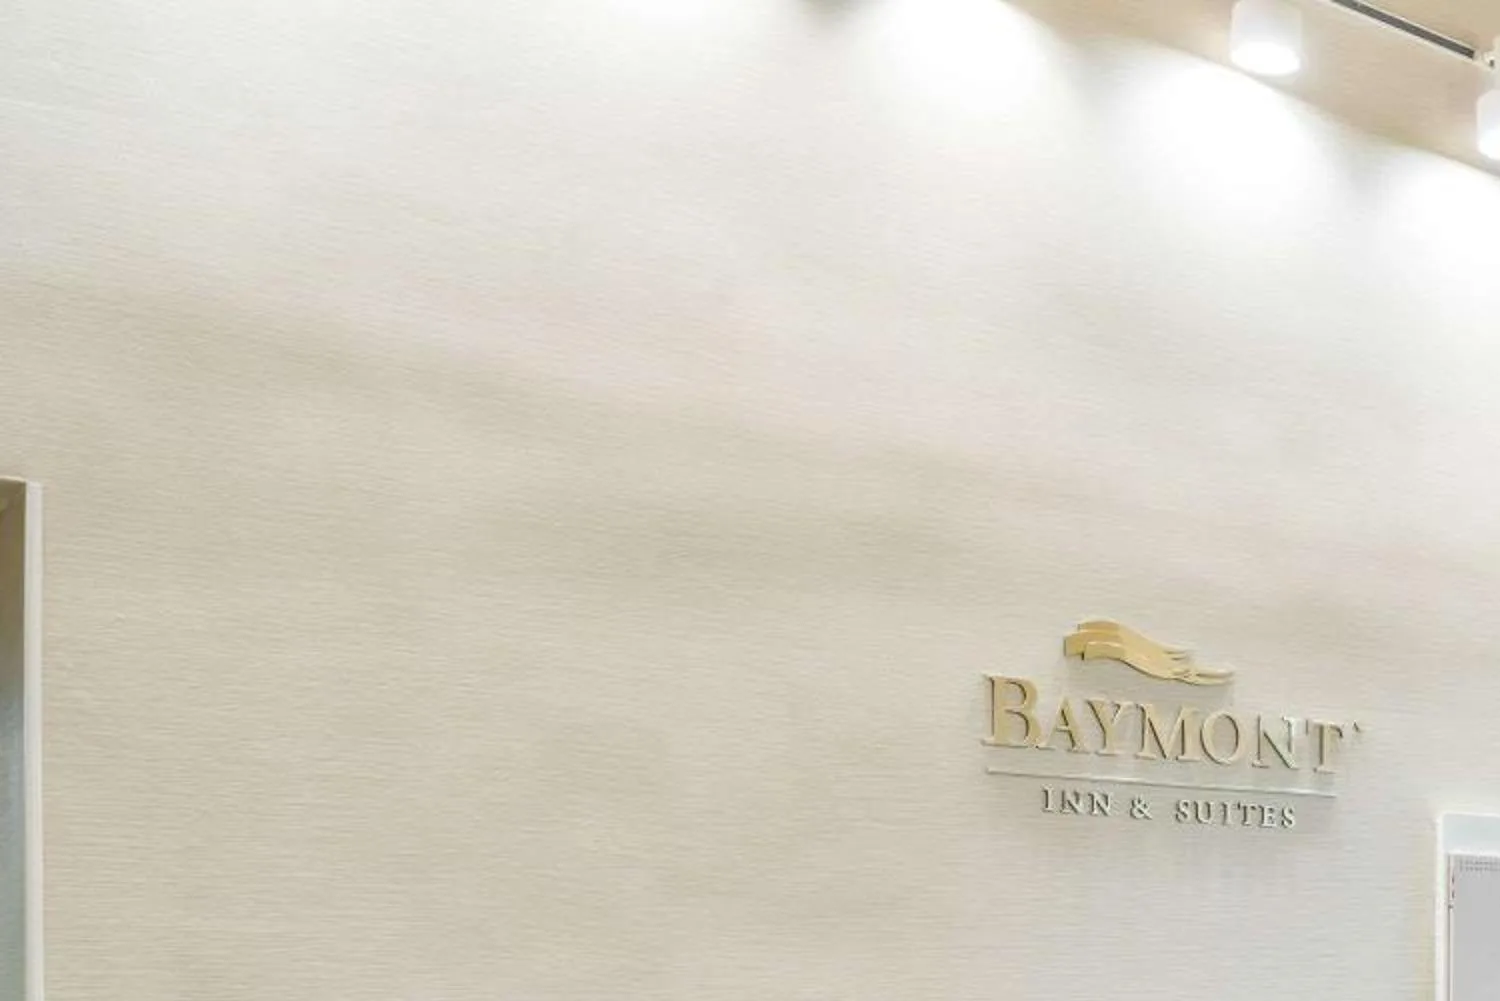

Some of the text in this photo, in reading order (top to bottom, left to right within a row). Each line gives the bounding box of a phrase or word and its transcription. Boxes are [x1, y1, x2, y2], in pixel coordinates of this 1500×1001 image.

[981, 673, 1344, 774] BAYMONT
[1041, 784, 1297, 829] INN & SUITES
